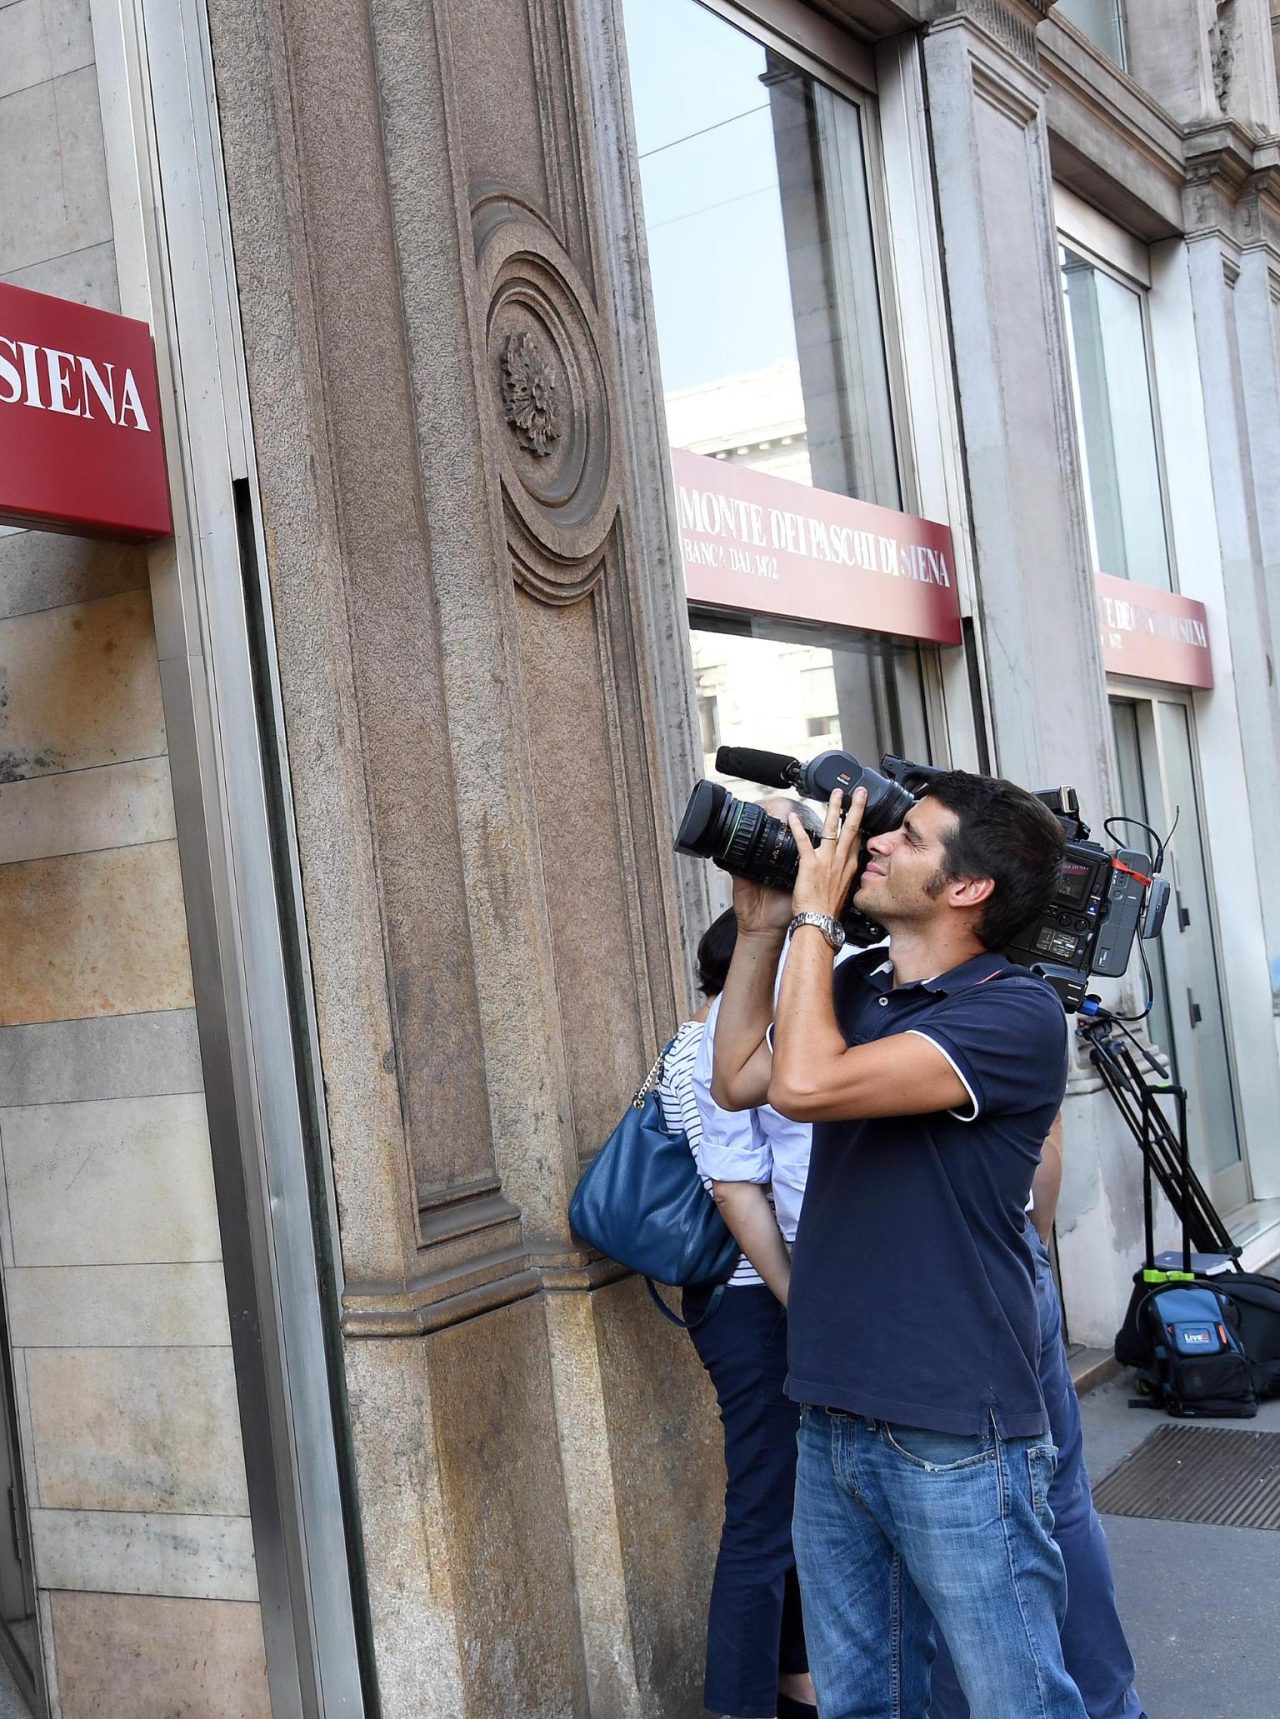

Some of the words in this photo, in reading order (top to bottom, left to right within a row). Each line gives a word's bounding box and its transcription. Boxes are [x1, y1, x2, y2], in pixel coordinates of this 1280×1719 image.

[679, 487, 766, 547] MONTE
[769, 509, 807, 556] DEI
[807, 519, 878, 572] PASCHI
[877, 537, 900, 577] DI
[899, 543, 951, 588] SIENA
[729, 549, 754, 575] DAL
